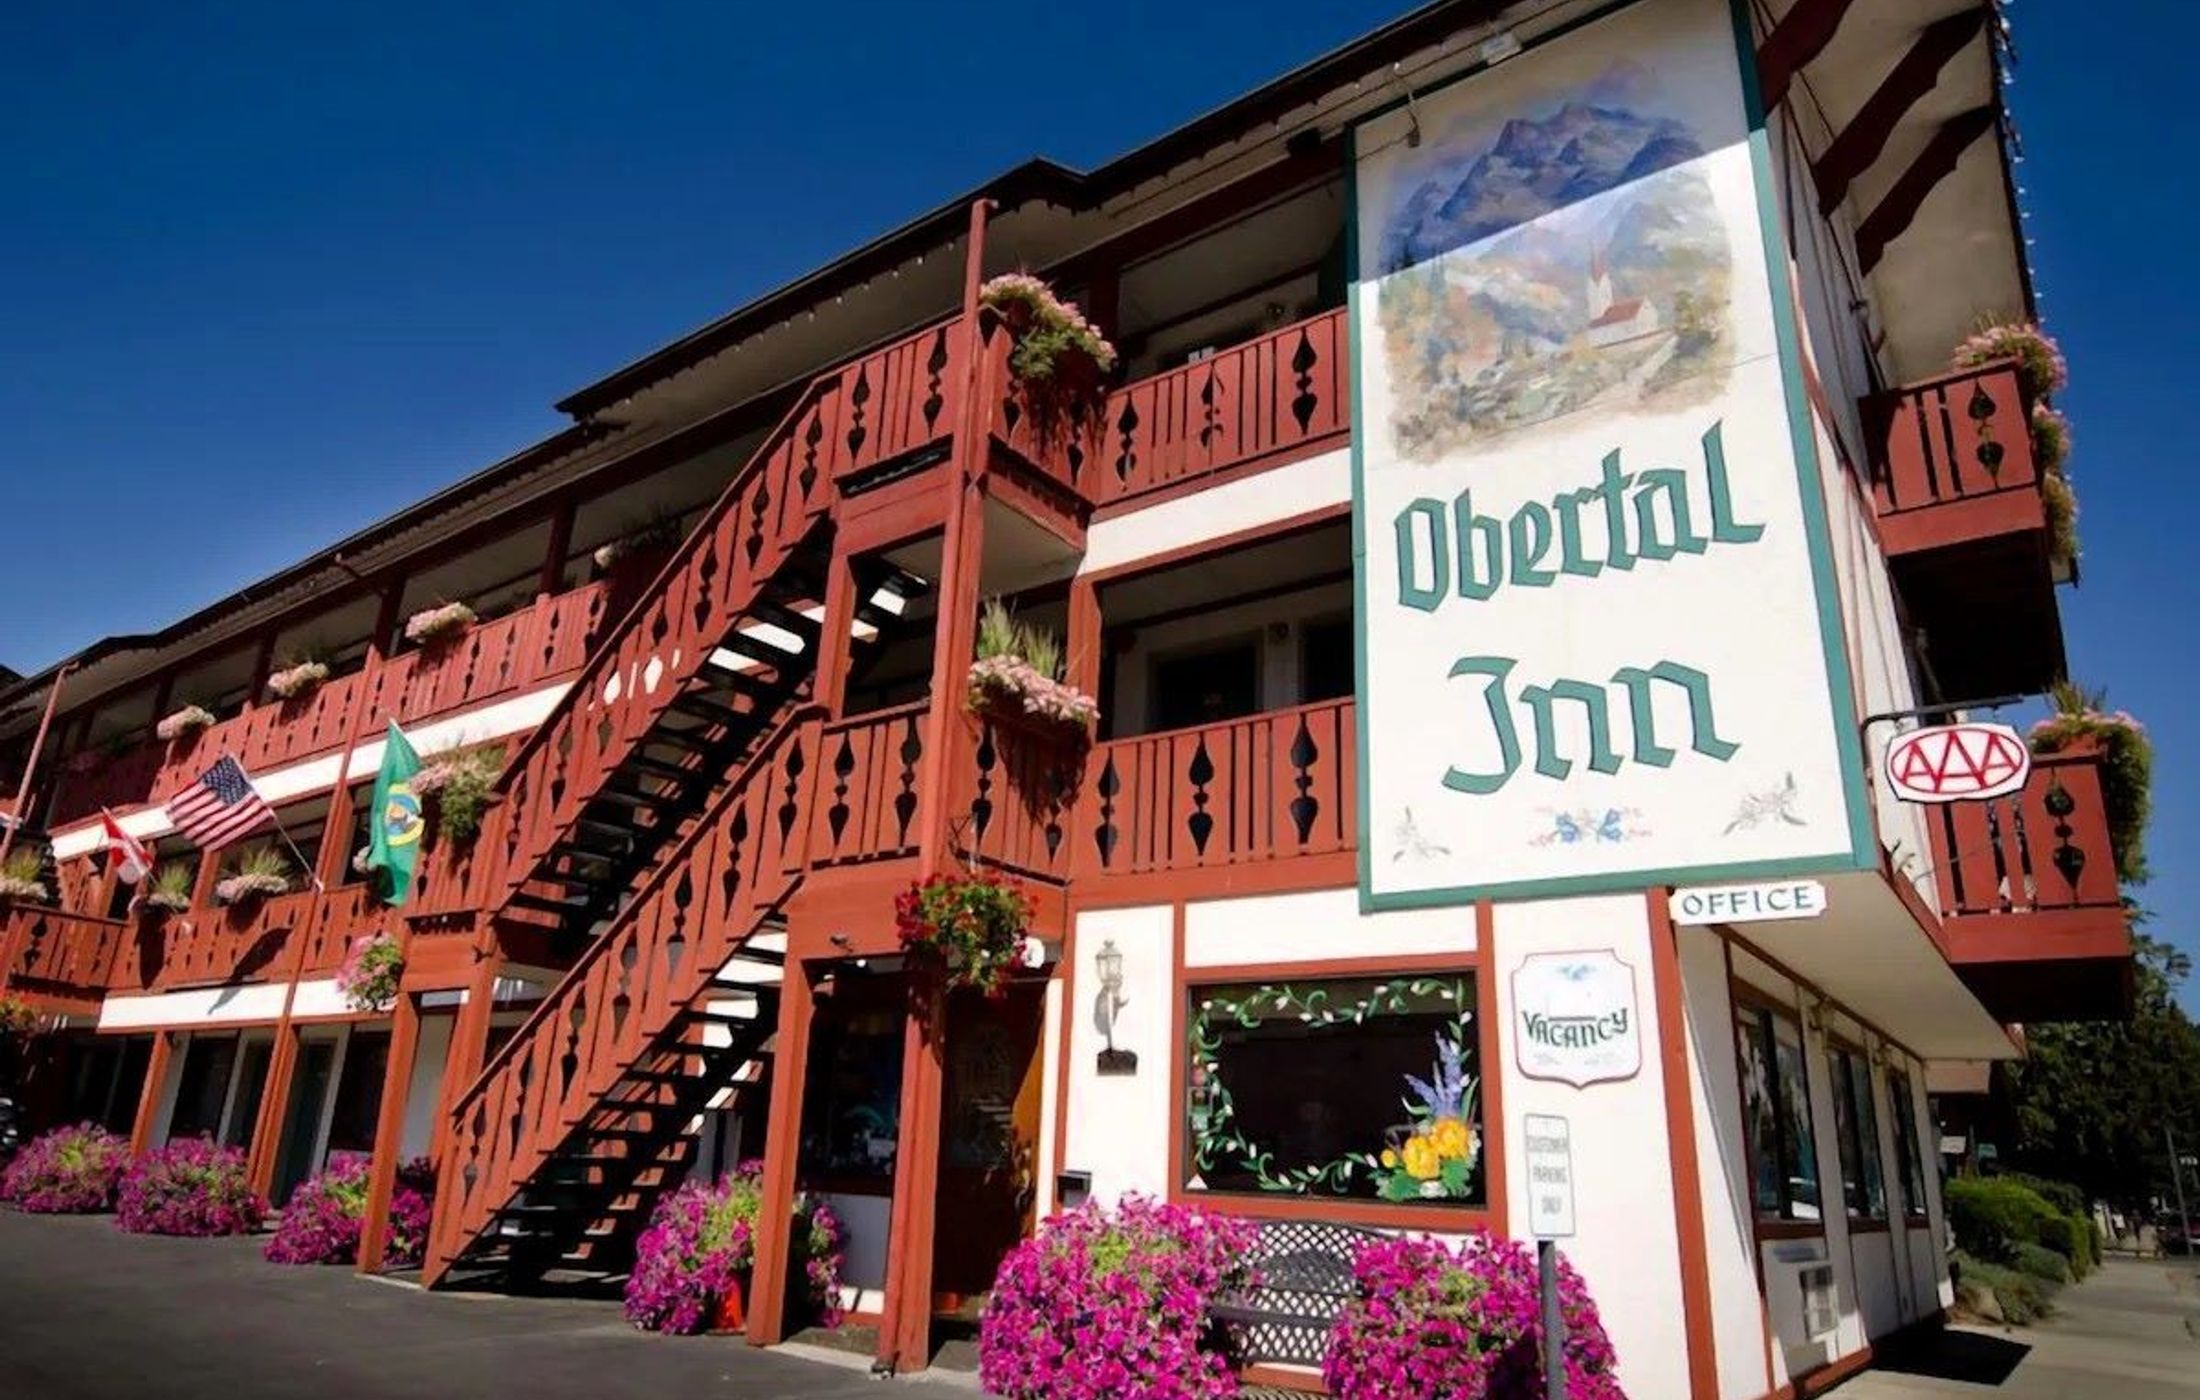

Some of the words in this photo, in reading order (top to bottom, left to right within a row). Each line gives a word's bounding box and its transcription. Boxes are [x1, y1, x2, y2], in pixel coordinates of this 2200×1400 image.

[1394, 419, 1766, 613] Obertal
[1441, 655, 1742, 795] Inn
[1901, 730, 2019, 793] AAA
[1682, 886, 1814, 916] OFFICE
